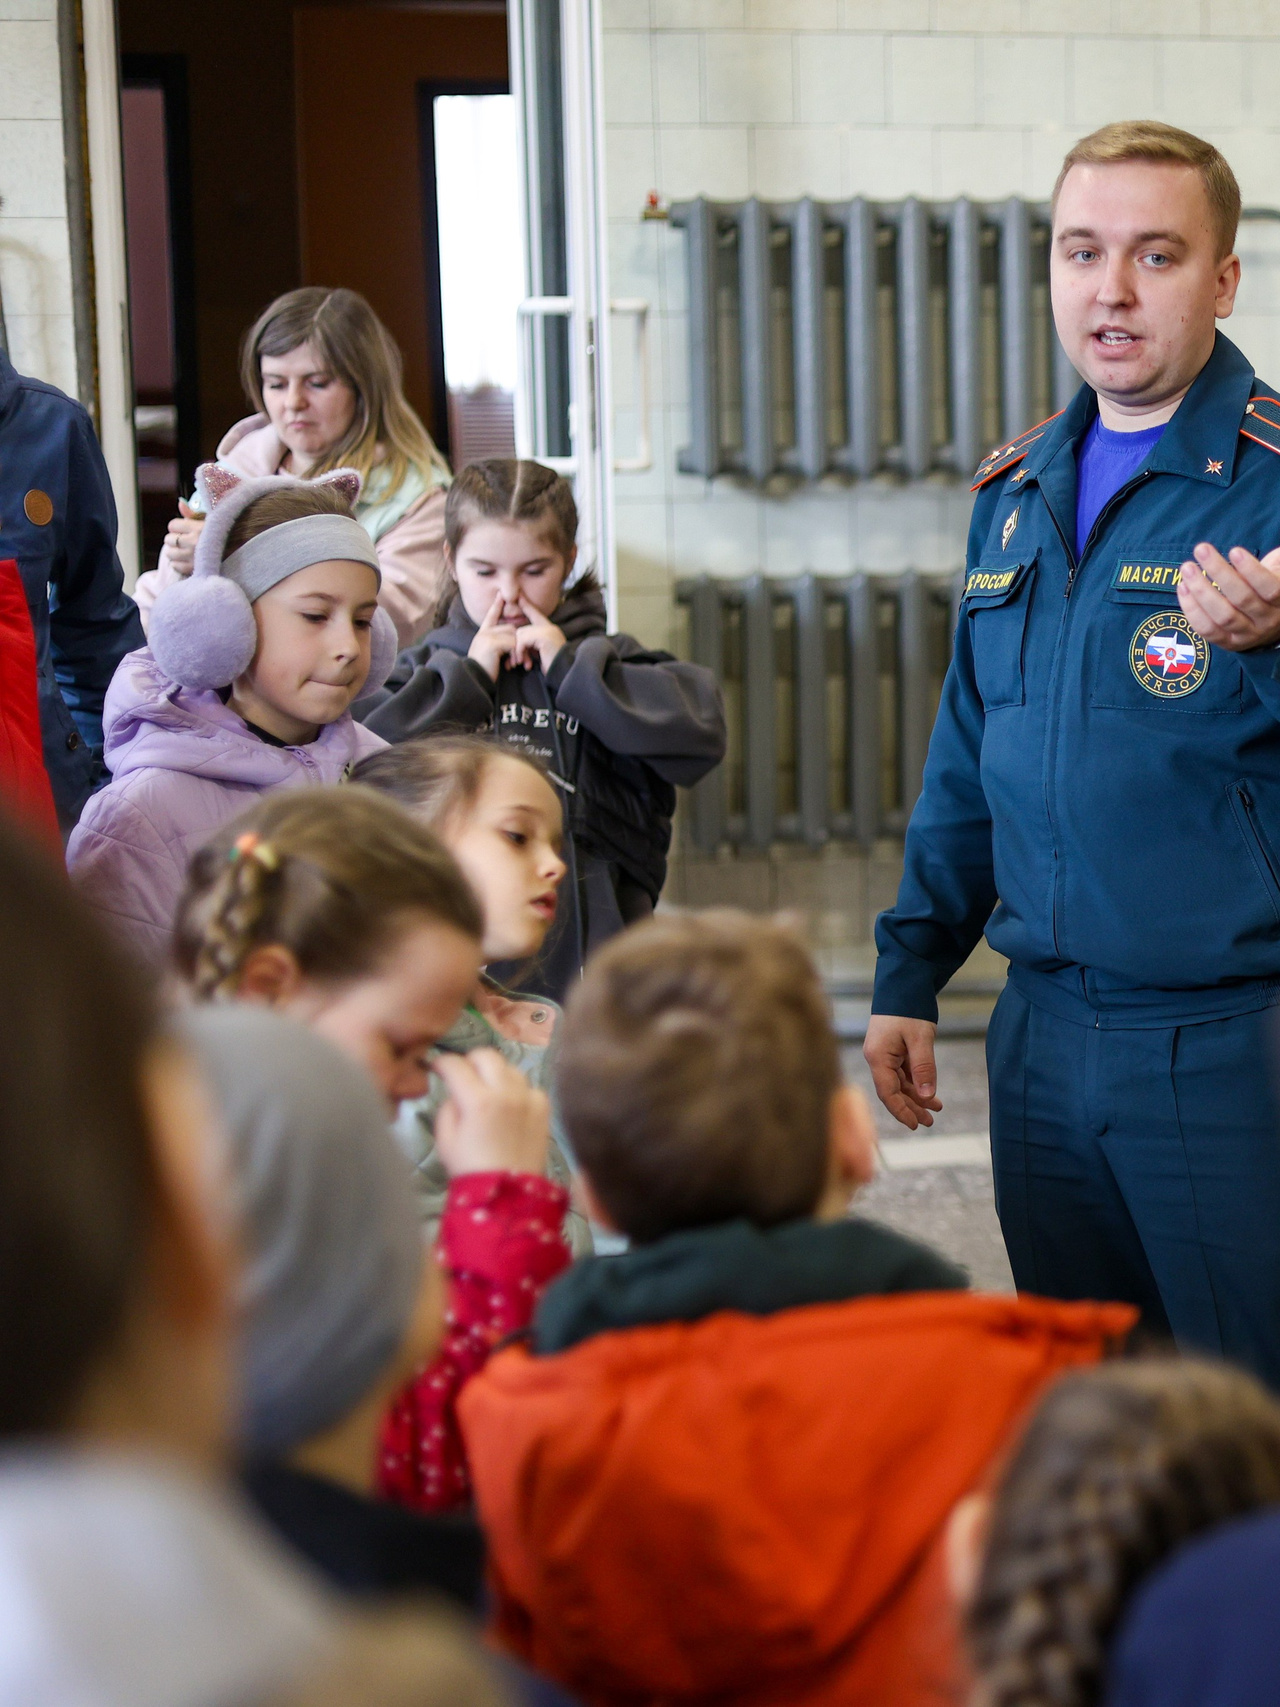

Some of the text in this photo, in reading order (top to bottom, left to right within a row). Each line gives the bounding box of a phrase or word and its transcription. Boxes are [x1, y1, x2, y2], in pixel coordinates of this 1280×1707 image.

[973, 571, 1015, 590] РОССИИ
[1119, 565, 1204, 587] МАСЯГИ
[1140, 617, 1165, 640] МЧС
[1134, 647, 1202, 693] EMERCOM
